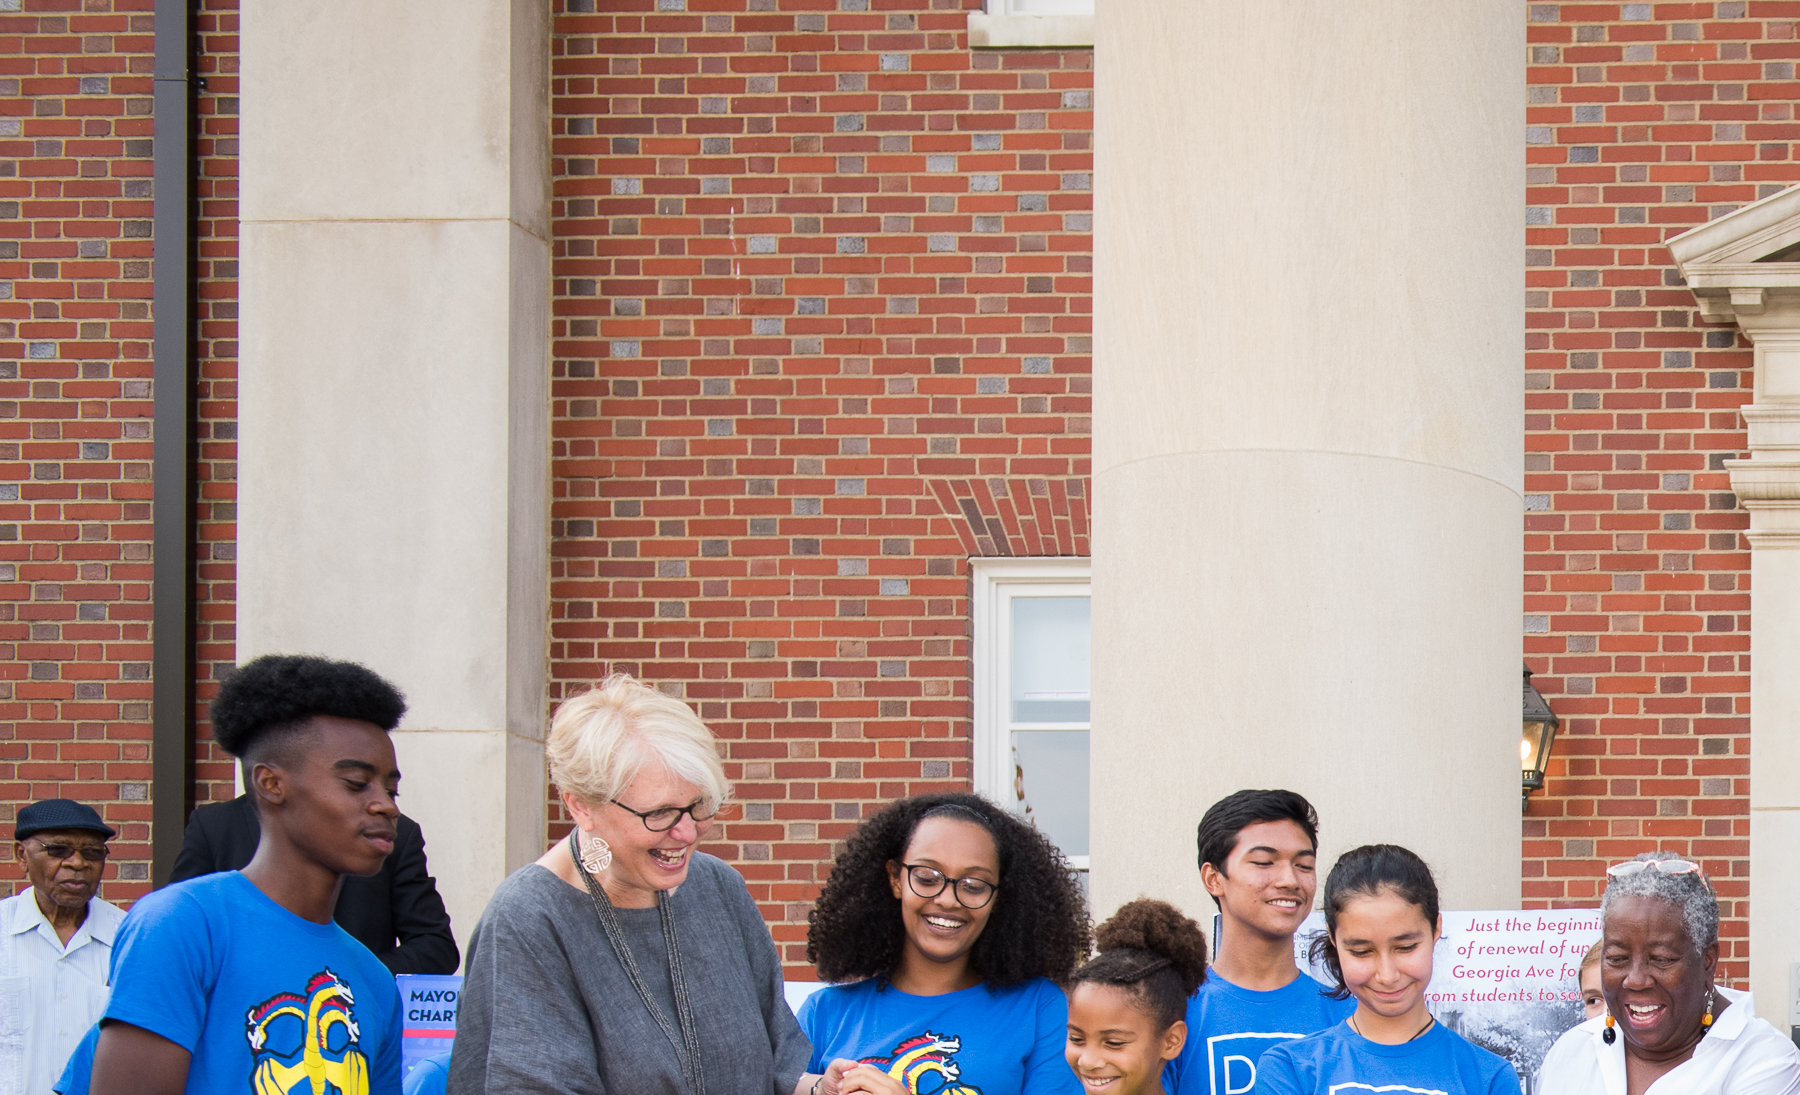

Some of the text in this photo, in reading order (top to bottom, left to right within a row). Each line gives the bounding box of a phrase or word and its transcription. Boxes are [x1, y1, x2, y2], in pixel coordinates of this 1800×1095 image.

[1467, 919, 1499, 931] Just
[1506, 918, 1531, 931] the
[1458, 941, 1475, 958] of
[1479, 941, 1544, 954] renewal
[1550, 940, 1567, 957] of
[1453, 965, 1519, 981] Georgia
[1526, 966, 1554, 977] Ave
[410, 990, 459, 1002] MAYO
[1462, 988, 1532, 1001] students
[1539, 988, 1554, 1000] to
[408, 1009, 455, 1021] CHAR
